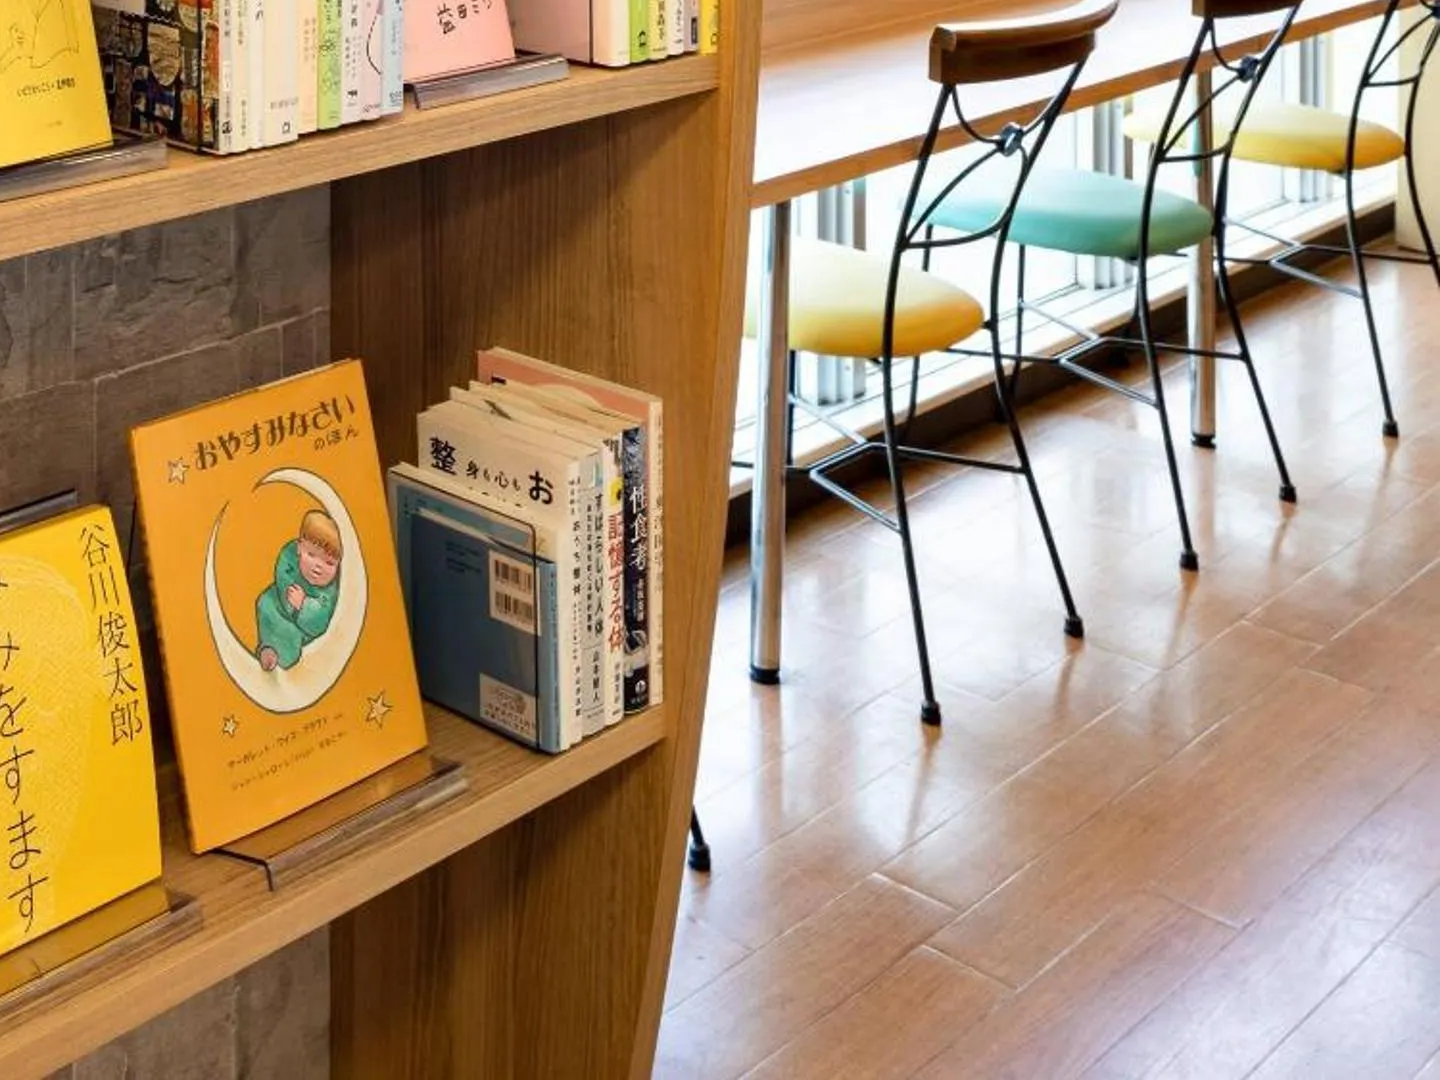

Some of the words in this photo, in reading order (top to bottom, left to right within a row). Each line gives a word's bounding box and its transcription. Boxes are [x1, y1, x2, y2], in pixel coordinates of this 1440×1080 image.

[194, 393, 357, 471] おやすみなさい
[313, 424, 360, 452] のほん
[428, 436, 458, 476] 整
[465, 459, 521, 492] 身も心も
[528, 469, 554, 505] お
[594, 492, 604, 637] すばらしい人体
[80, 523, 143, 746] 谷川俊太郎
